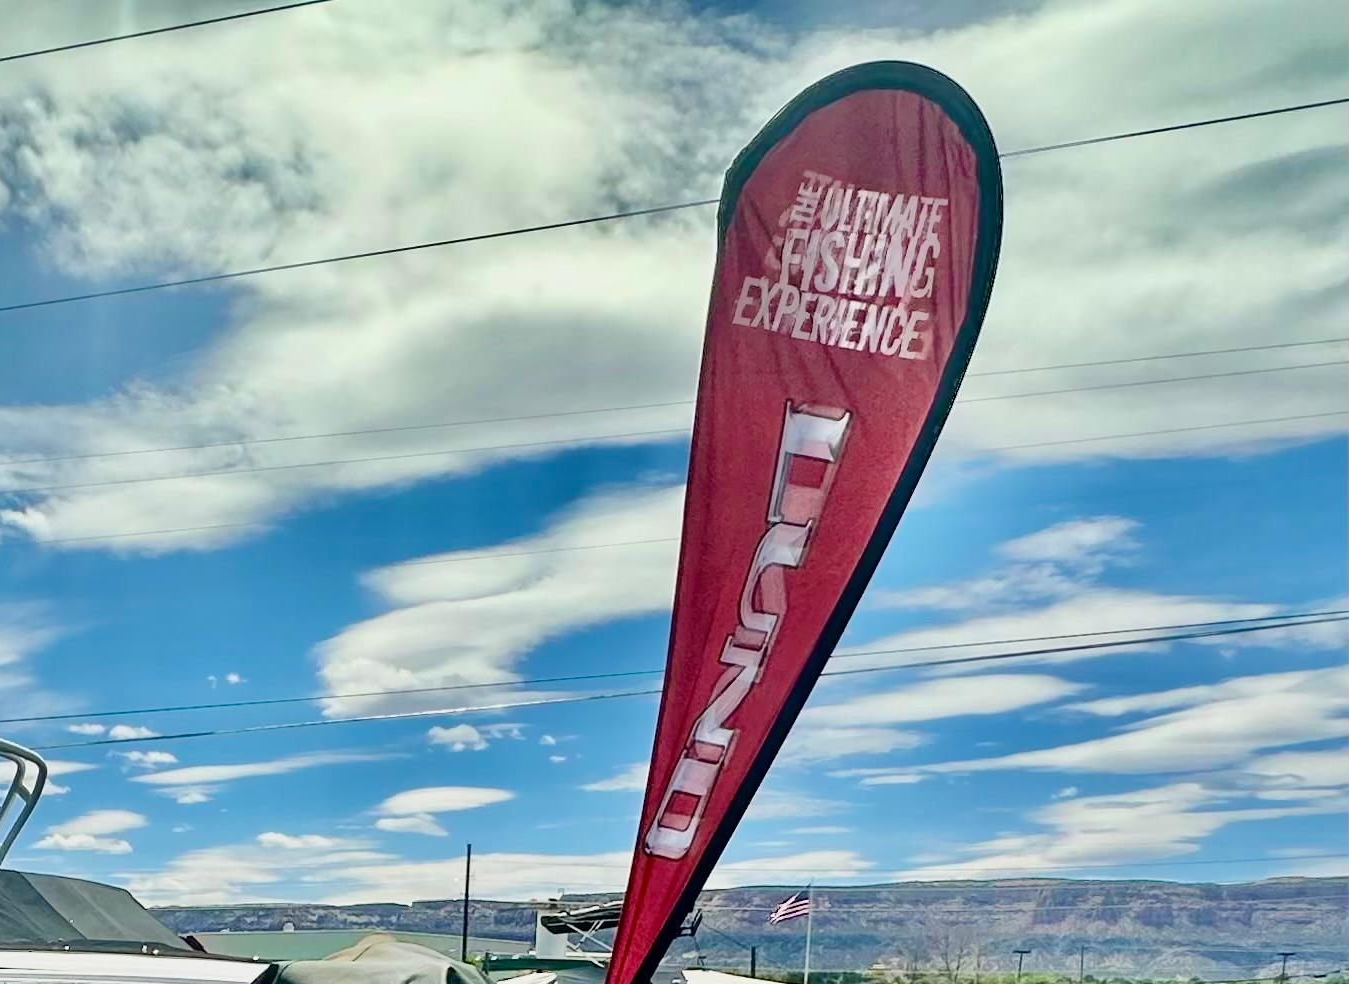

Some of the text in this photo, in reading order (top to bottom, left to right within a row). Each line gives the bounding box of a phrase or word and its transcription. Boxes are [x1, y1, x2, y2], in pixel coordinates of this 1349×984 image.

[820, 183, 949, 242] ULTIMATE
[779, 228, 942, 299] FISHING
[731, 275, 931, 360] EXPERIENCE
[645, 399, 852, 860] LUND
